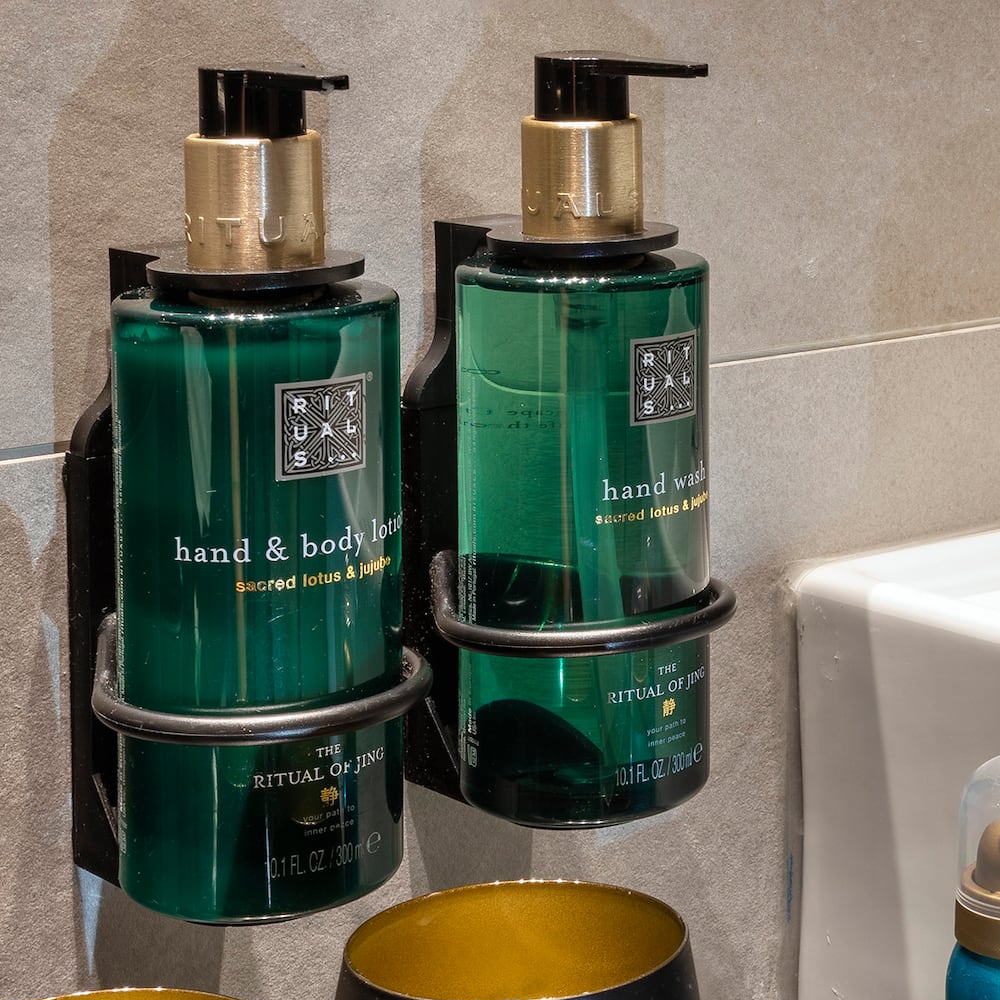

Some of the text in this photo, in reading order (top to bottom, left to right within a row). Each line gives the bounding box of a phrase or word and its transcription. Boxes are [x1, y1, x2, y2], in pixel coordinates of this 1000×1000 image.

[602, 460, 706, 501] hand wash
[595, 508, 645, 525] sacred
[650, 504, 680, 519] lotus
[682, 499, 689, 511] &
[174, 511, 403, 563] hand & body lotio
[235, 575, 296, 593] sacred
[303, 570, 341, 588] lotus
[346, 565, 355, 579] &
[658, 662, 677, 676] THE
[607, 666, 705, 704] RITUAL OF JING
[646, 725, 663, 737] your
[664, 719, 679, 733] path
[316, 743, 342, 758] THE
[253, 747, 385, 789] RITUAL OF JING
[615, 766, 633, 786] 10.1
